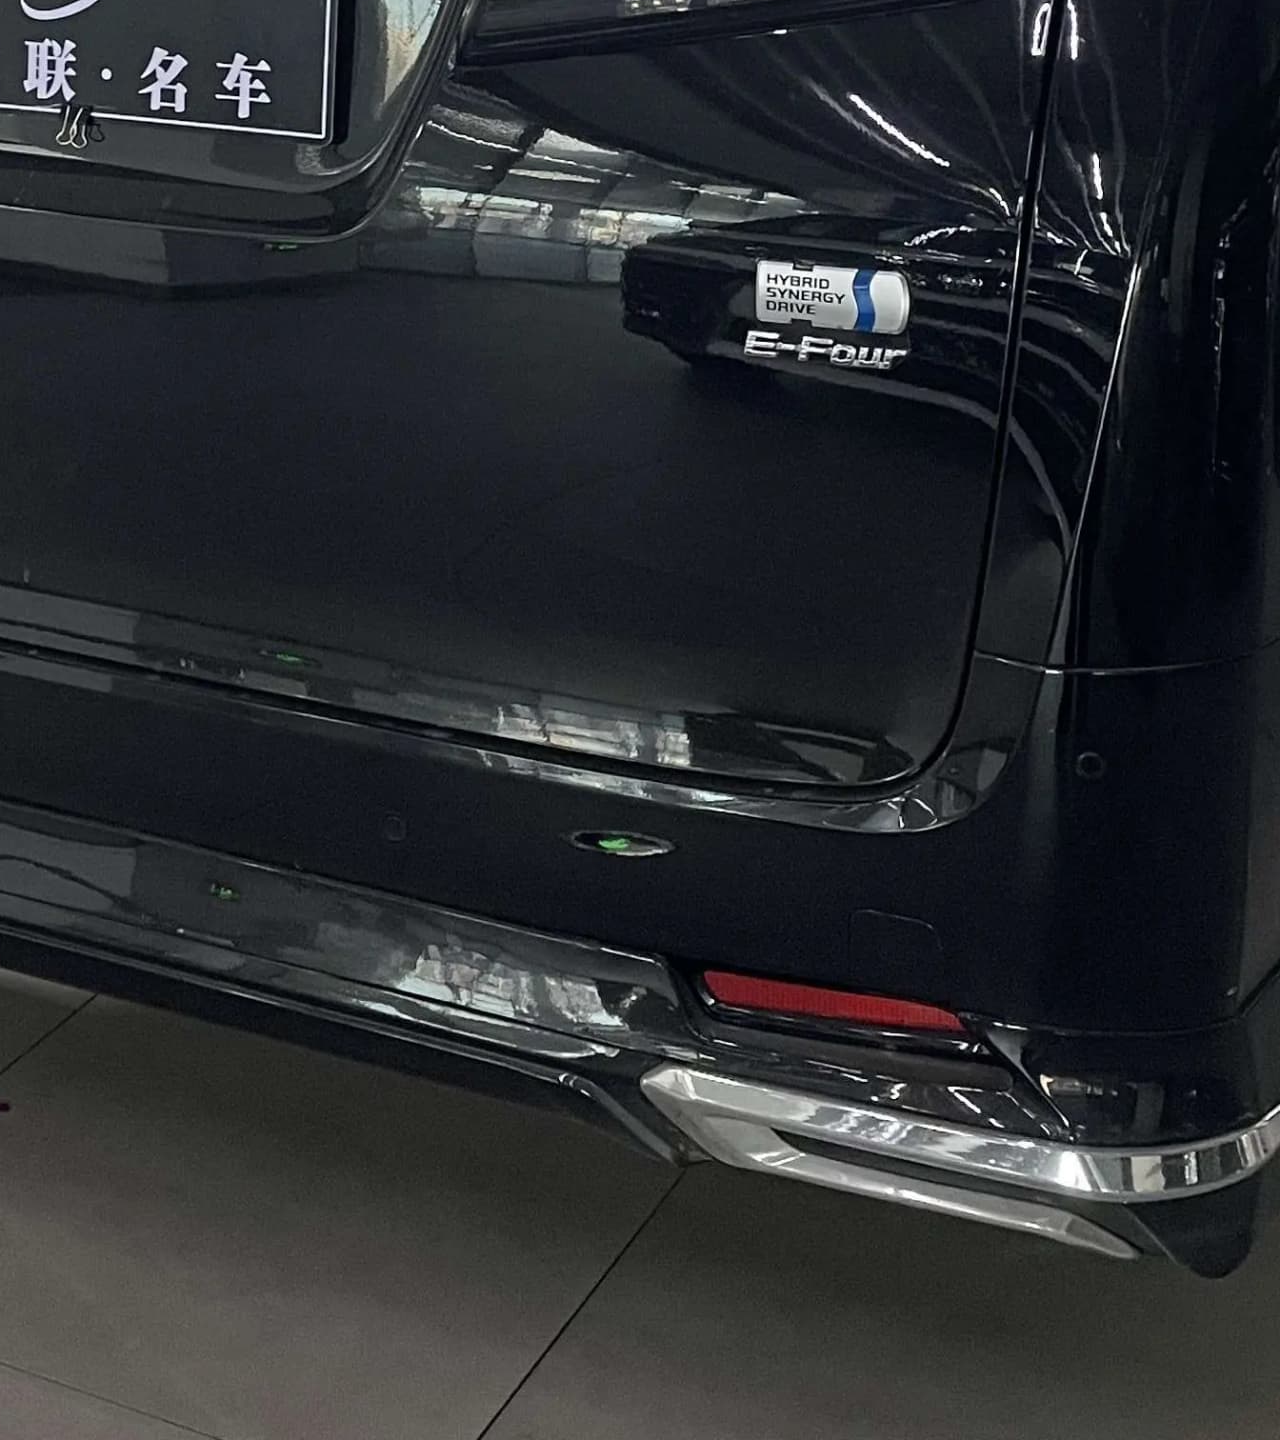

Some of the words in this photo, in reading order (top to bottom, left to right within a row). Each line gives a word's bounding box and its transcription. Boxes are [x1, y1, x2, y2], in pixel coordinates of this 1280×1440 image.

[766, 273, 830, 290] HYBRID
[766, 287, 846, 305] SYNERGY
[766, 300, 817, 315] DRIVE
[743, 330, 908, 370] E-Four
